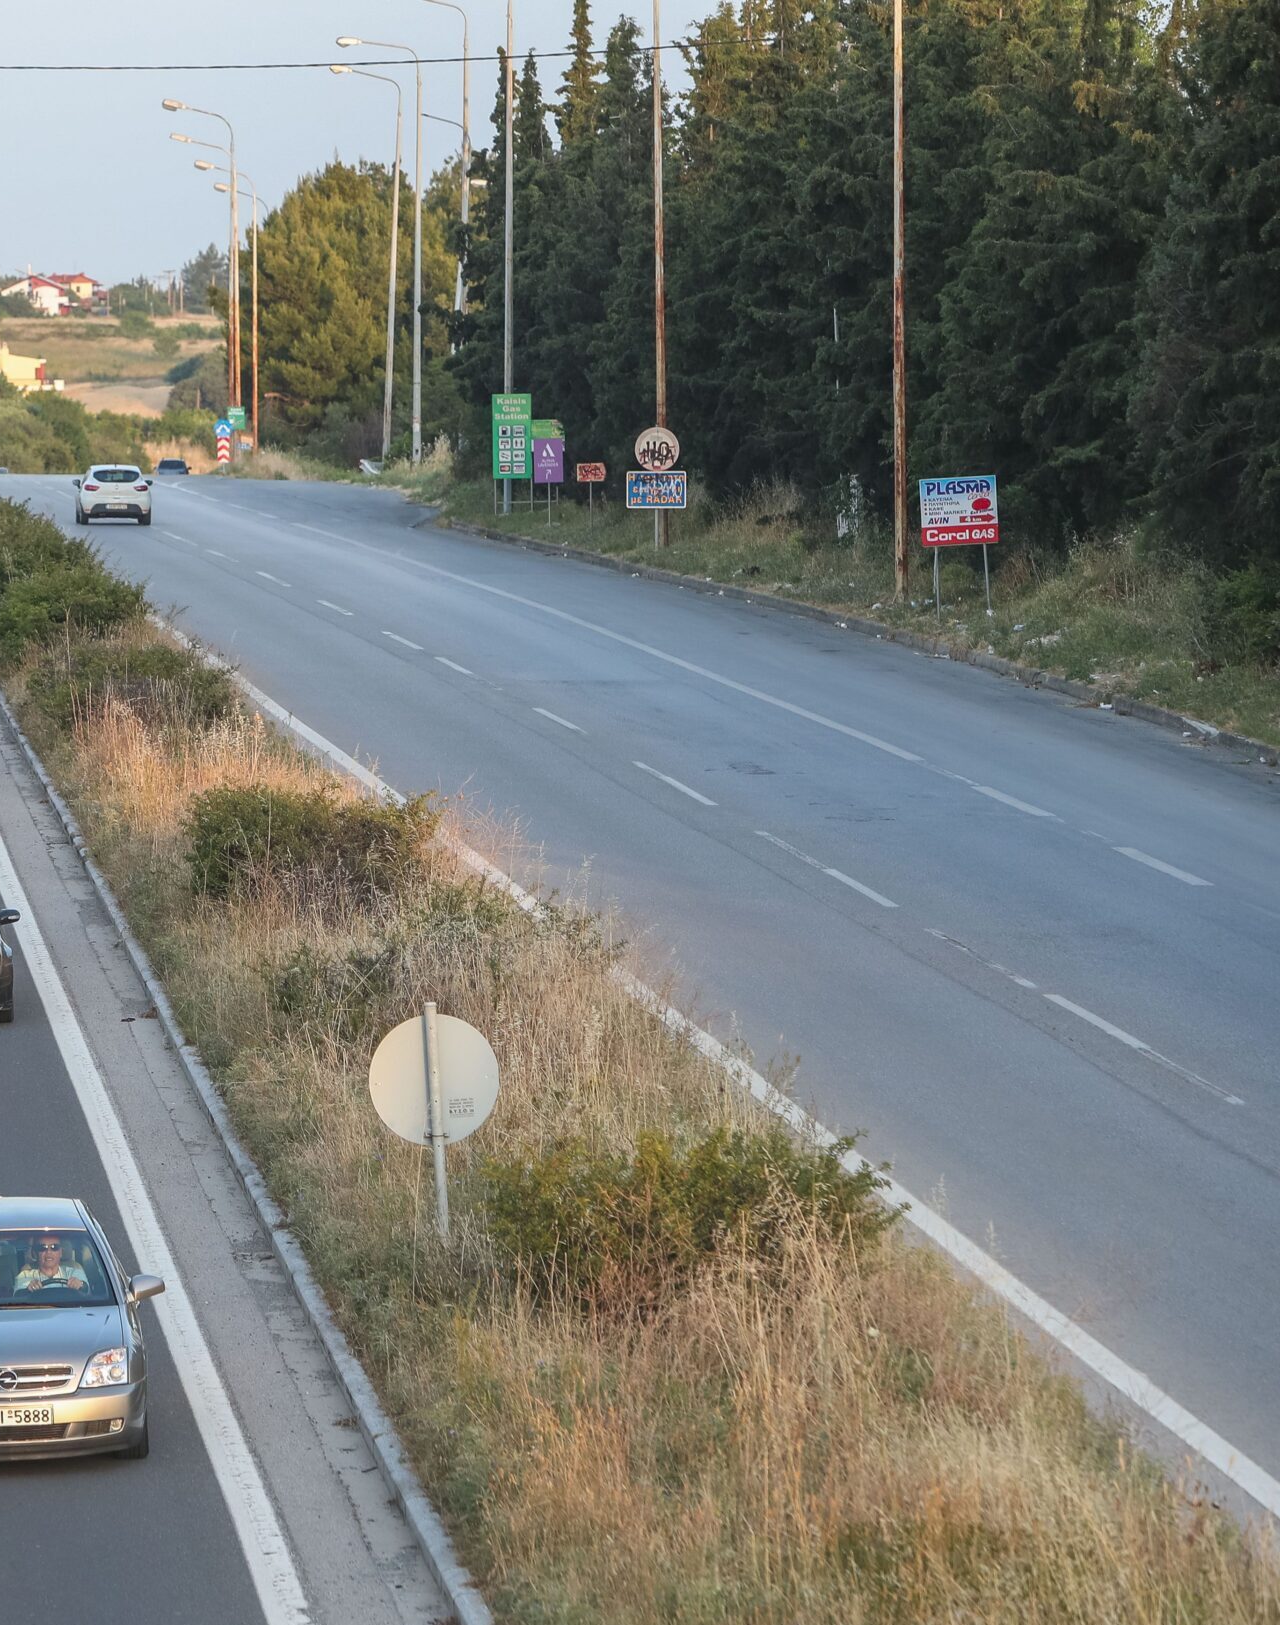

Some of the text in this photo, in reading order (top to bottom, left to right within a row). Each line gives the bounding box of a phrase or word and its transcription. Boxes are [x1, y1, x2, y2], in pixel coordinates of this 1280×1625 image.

[924, 480, 991, 496] PLASMA
[928, 517, 949, 525] AVIN
[926, 528, 995, 542] Coral GAS
